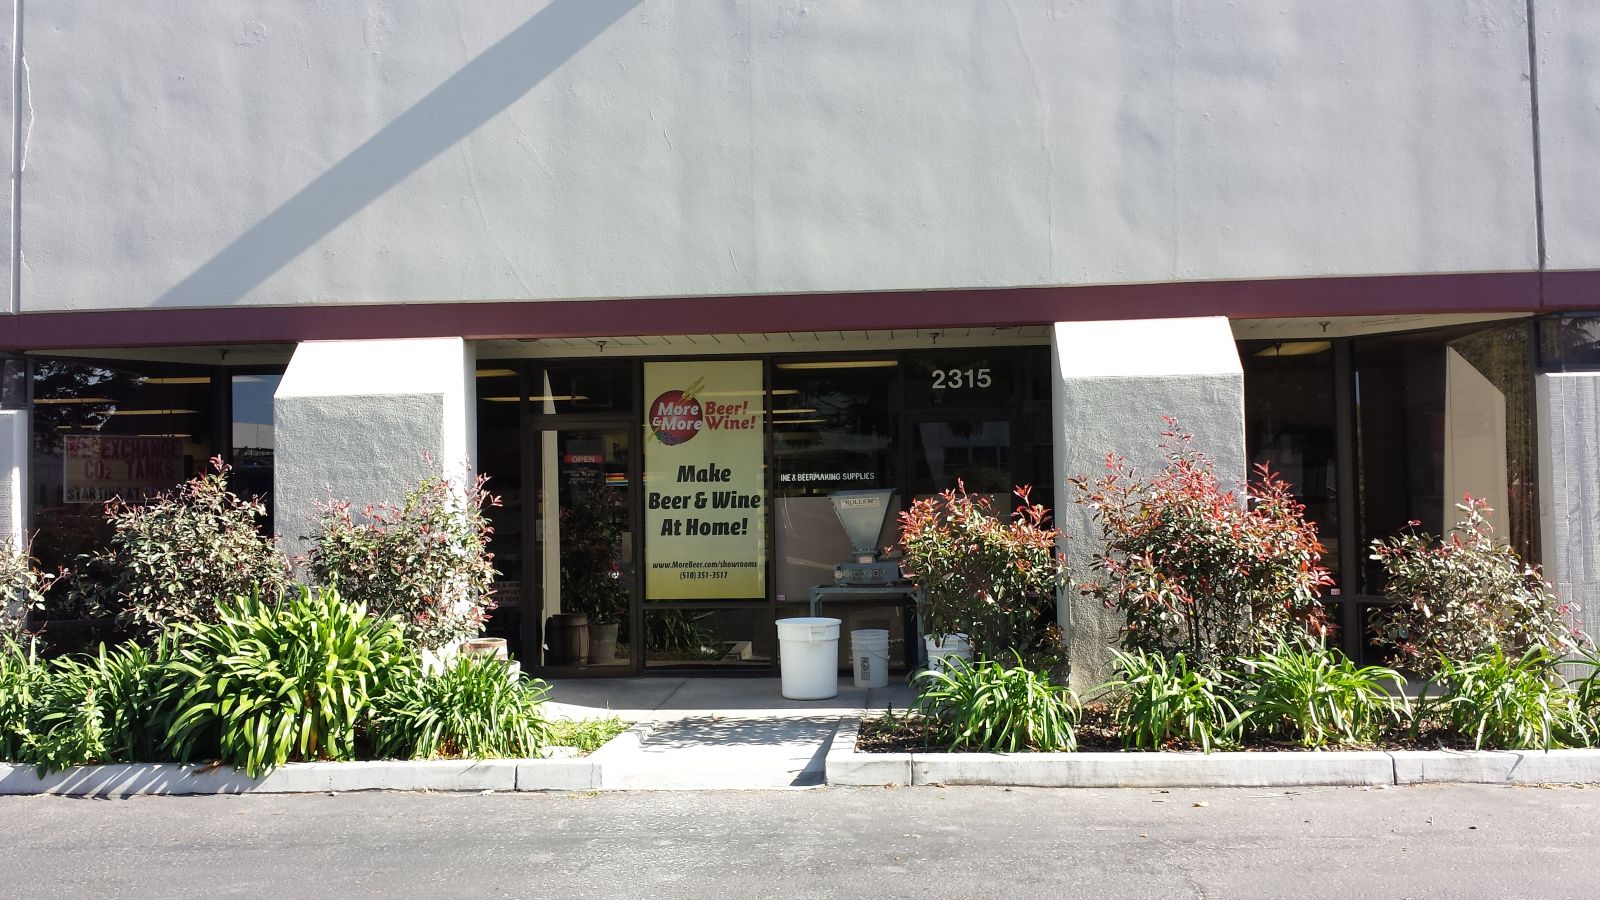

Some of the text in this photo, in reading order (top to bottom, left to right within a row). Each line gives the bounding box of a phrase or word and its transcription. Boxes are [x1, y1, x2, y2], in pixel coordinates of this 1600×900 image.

[932, 368, 992, 389] 2315
[657, 401, 749, 416] More Beer!
[704, 415, 757, 431] Wine!
[101, 439, 180, 459] EXCHANGE
[571, 455, 596, 464] OPEN
[125, 460, 175, 480] TANKS
[676, 462, 732, 483] Make
[791, 473, 797, 482] &
[797, 472, 841, 482] BEERMAKING
[842, 472, 875, 481] SUPPLIES
[647, 490, 762, 510] Beer & Wine
[660, 517, 749, 536] At Home!
[652, 560, 758, 569] www.MoreBeer.com/showrooms
[679, 571, 729, 580] (510) 351-3517
